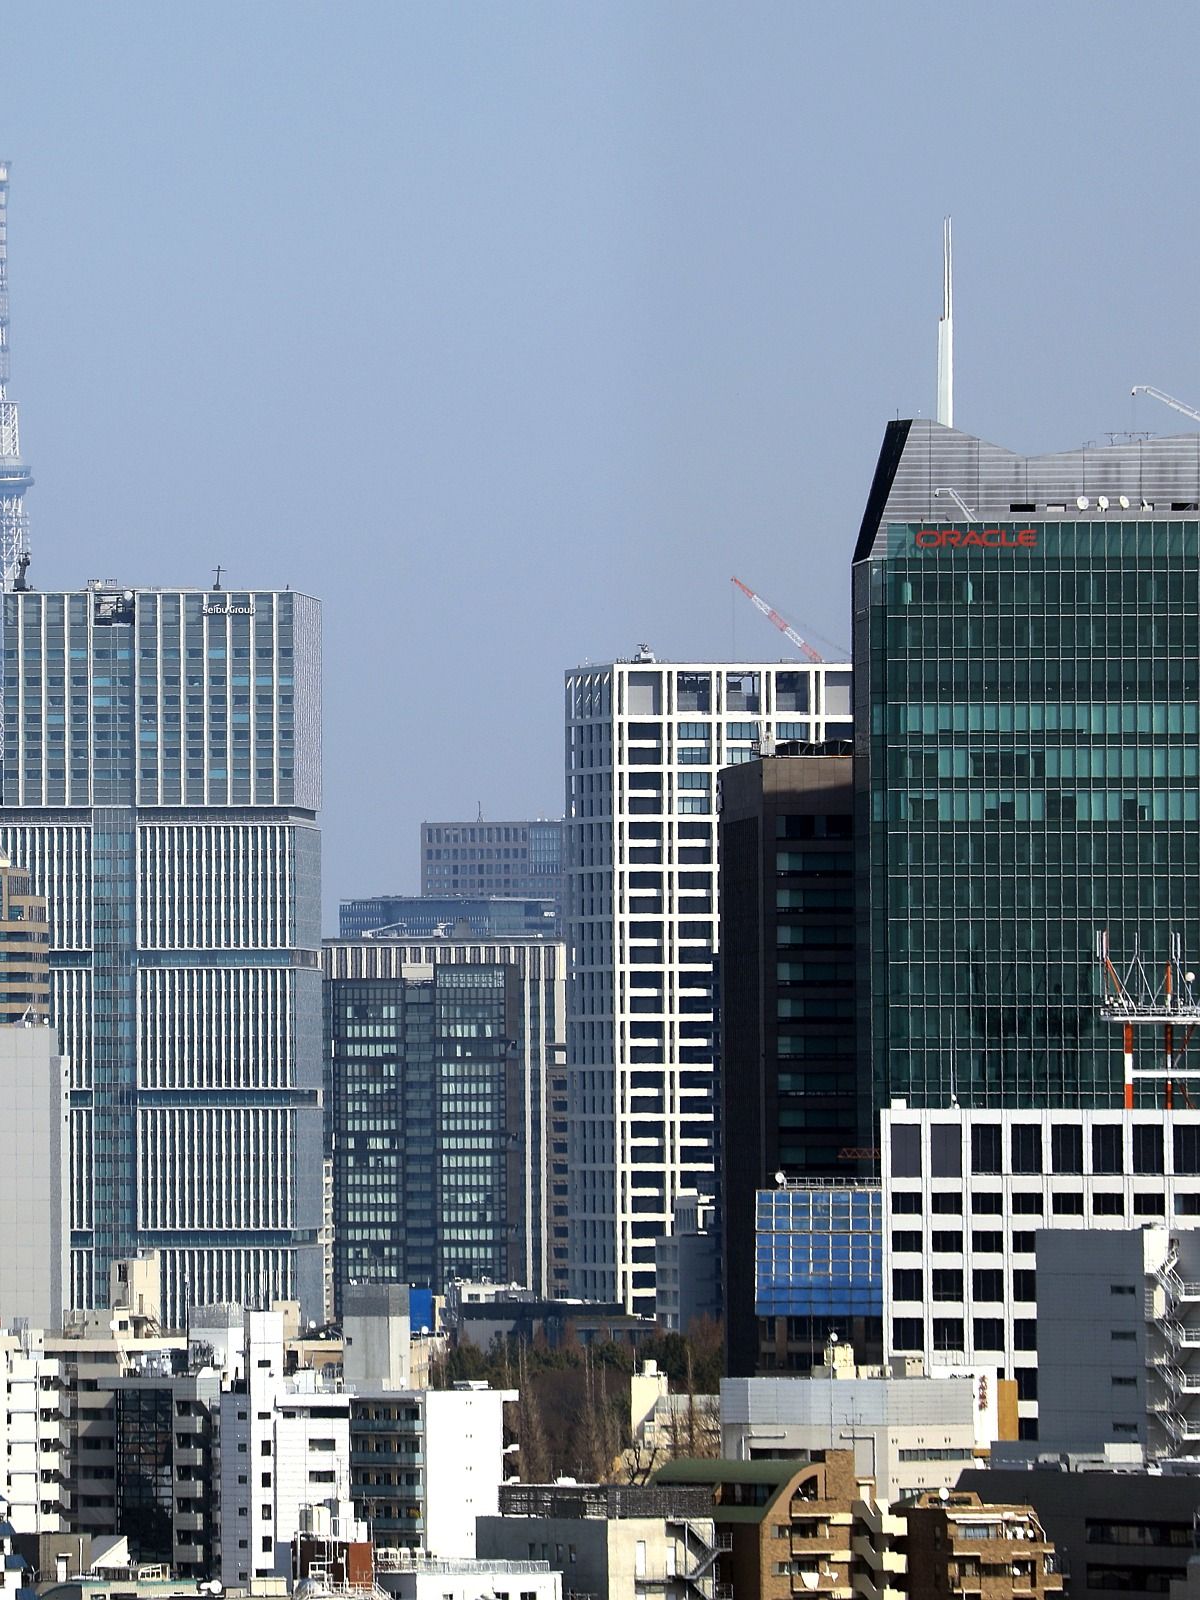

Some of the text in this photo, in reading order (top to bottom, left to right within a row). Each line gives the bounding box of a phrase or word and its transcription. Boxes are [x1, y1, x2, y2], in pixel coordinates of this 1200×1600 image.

[916, 530, 1037, 547] ORACLE
[202, 604, 256, 615] Seibu Group
